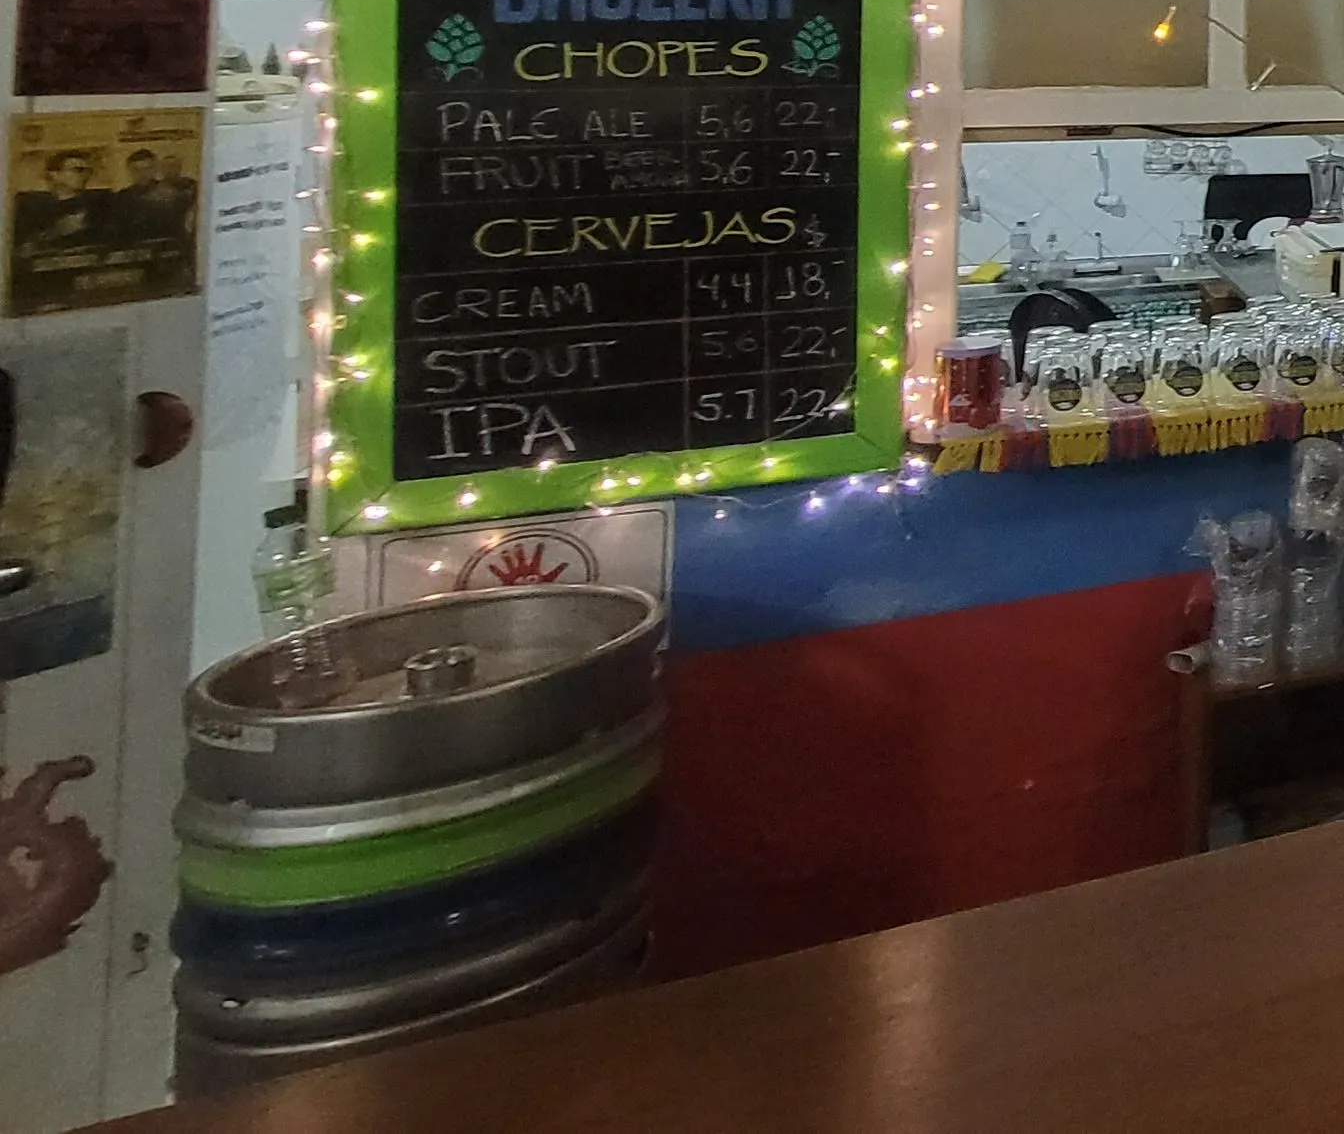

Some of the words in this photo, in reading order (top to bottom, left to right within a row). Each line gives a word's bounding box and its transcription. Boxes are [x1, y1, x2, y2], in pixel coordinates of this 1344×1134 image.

[514, 39, 769, 82] CHOPES
[437, 101, 560, 143] PALE
[583, 110, 653, 142] ALE
[440, 153, 596, 195] FRUIT
[473, 207, 798, 258] CERVEJAS
[413, 281, 594, 324] CREAM
[423, 339, 619, 395] STOUT
[428, 402, 577, 460] IPA
